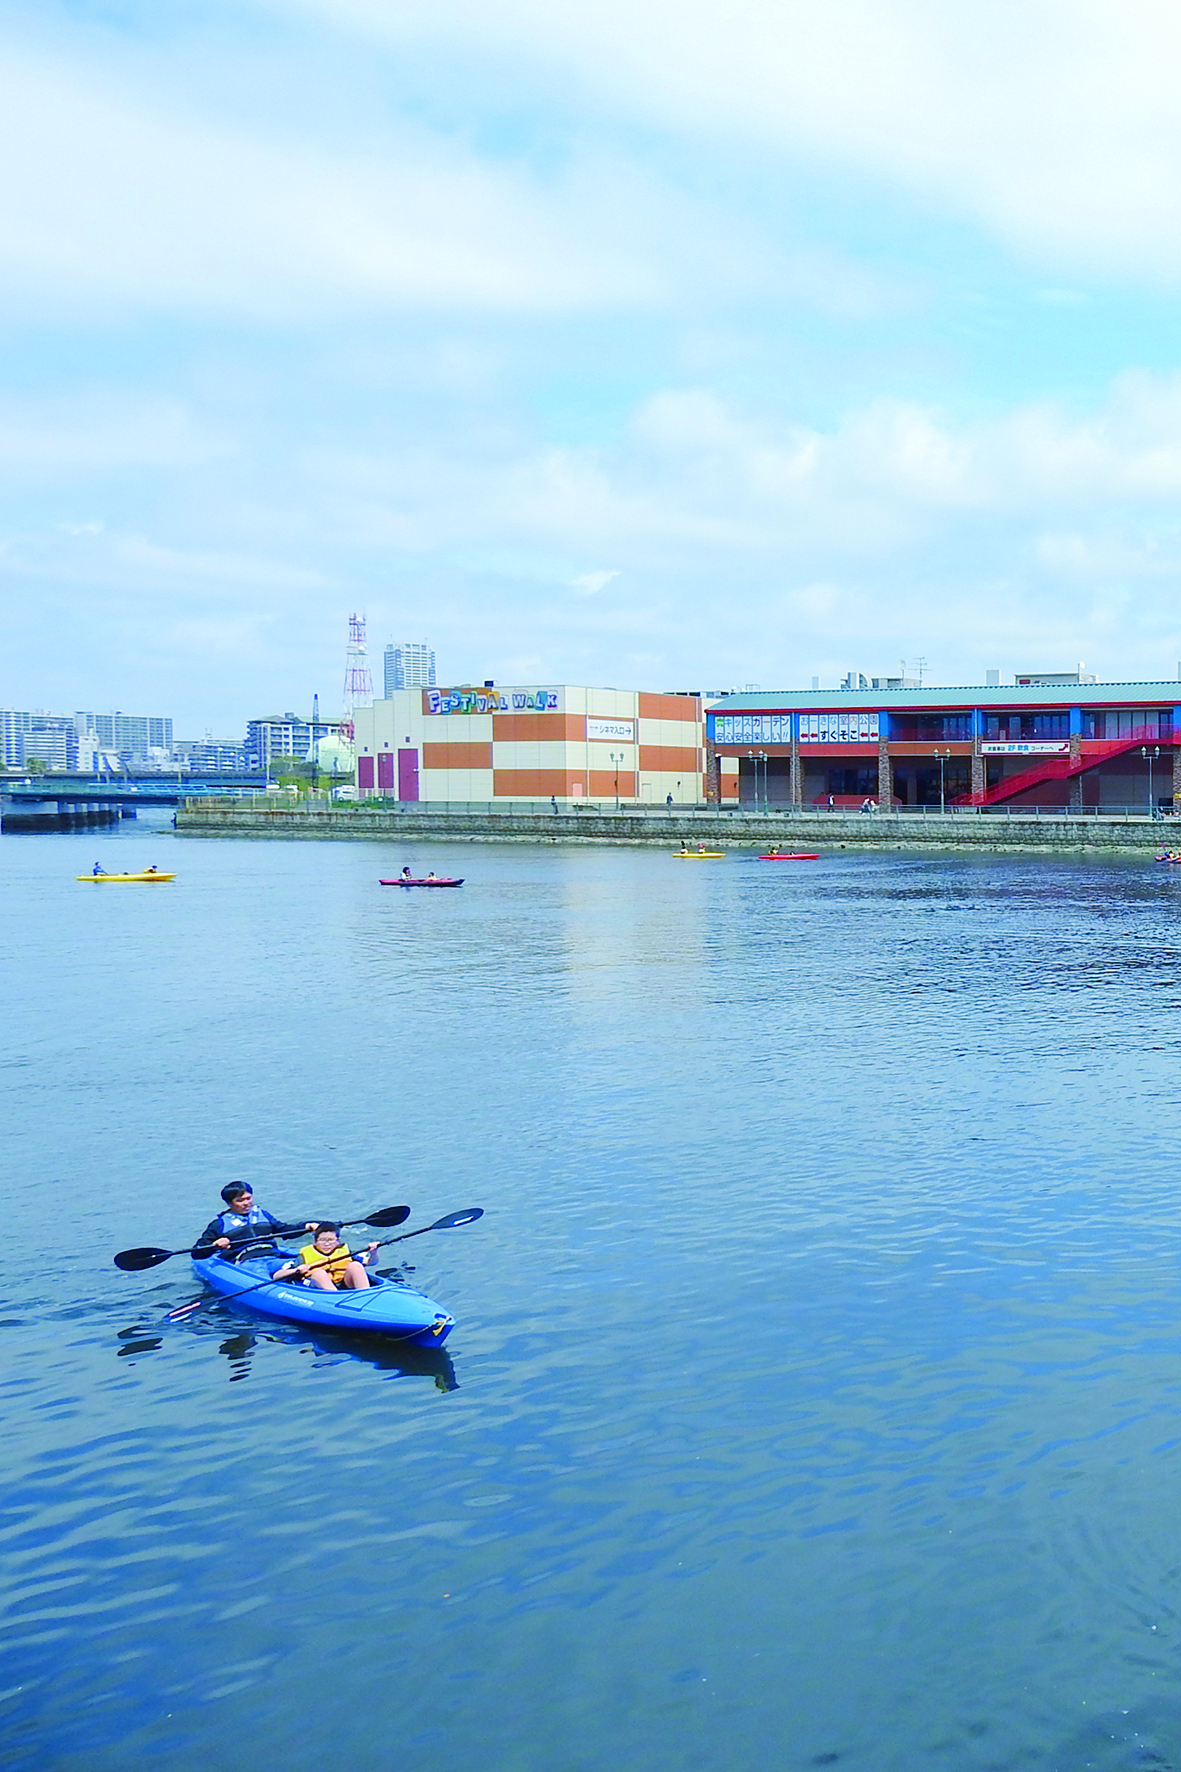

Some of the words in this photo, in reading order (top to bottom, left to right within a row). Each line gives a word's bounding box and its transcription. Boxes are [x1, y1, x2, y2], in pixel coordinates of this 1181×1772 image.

[427, 690, 509, 714] FESTIVAL
[512, 690, 558, 712] WALK
[800, 715, 879, 727] おーきな室内公園
[599, 726, 625, 735] シネマ入口
[820, 731, 858, 741] すぐそこ
